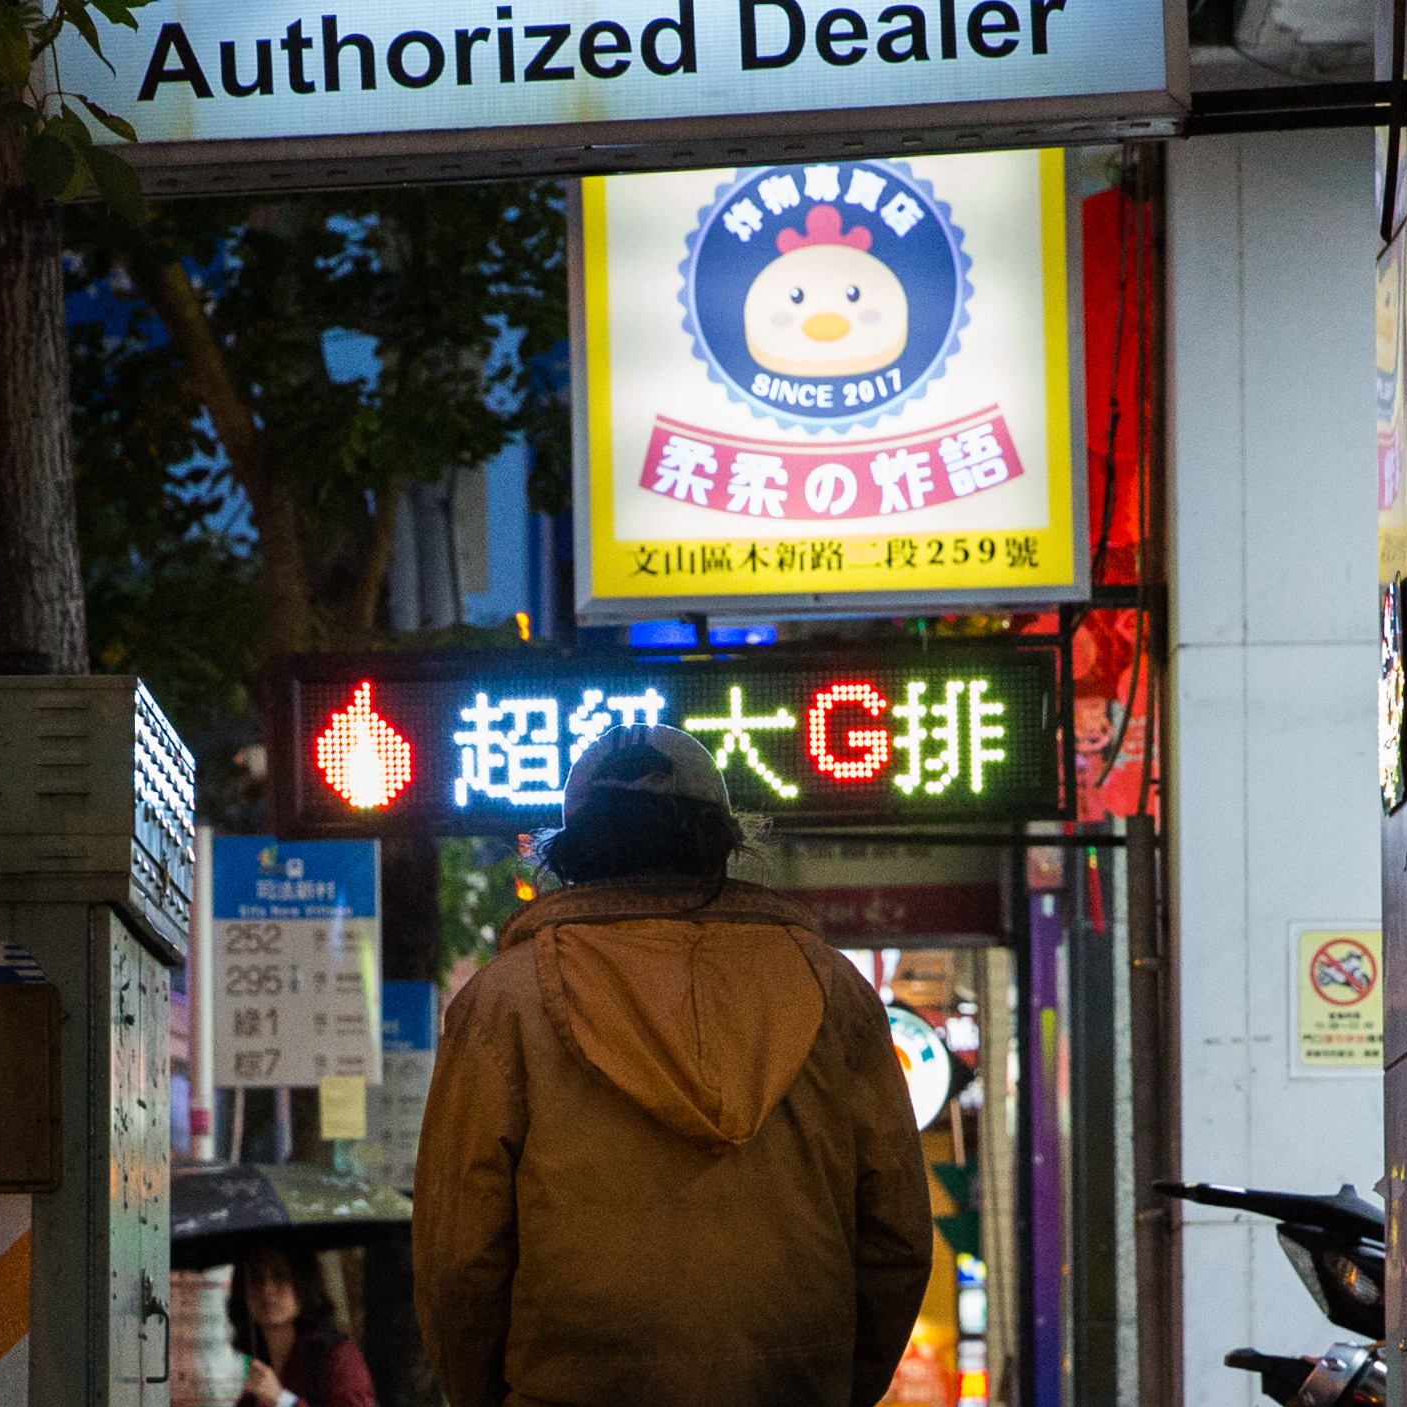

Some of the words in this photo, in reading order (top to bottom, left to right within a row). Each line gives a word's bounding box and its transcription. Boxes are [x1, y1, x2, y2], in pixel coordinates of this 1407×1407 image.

[137, 0, 698, 102] Authorized
[740, 0, 1065, 71] Dealer
[751, 372, 834, 408] SINCE
[843, 368, 903, 403] 2017
[653, 422, 1009, 517] 柔柔の炸語
[629, 536, 1040, 577] 文山區木新路二段259號
[225, 923, 283, 954] 252
[225, 965, 283, 997] 295
